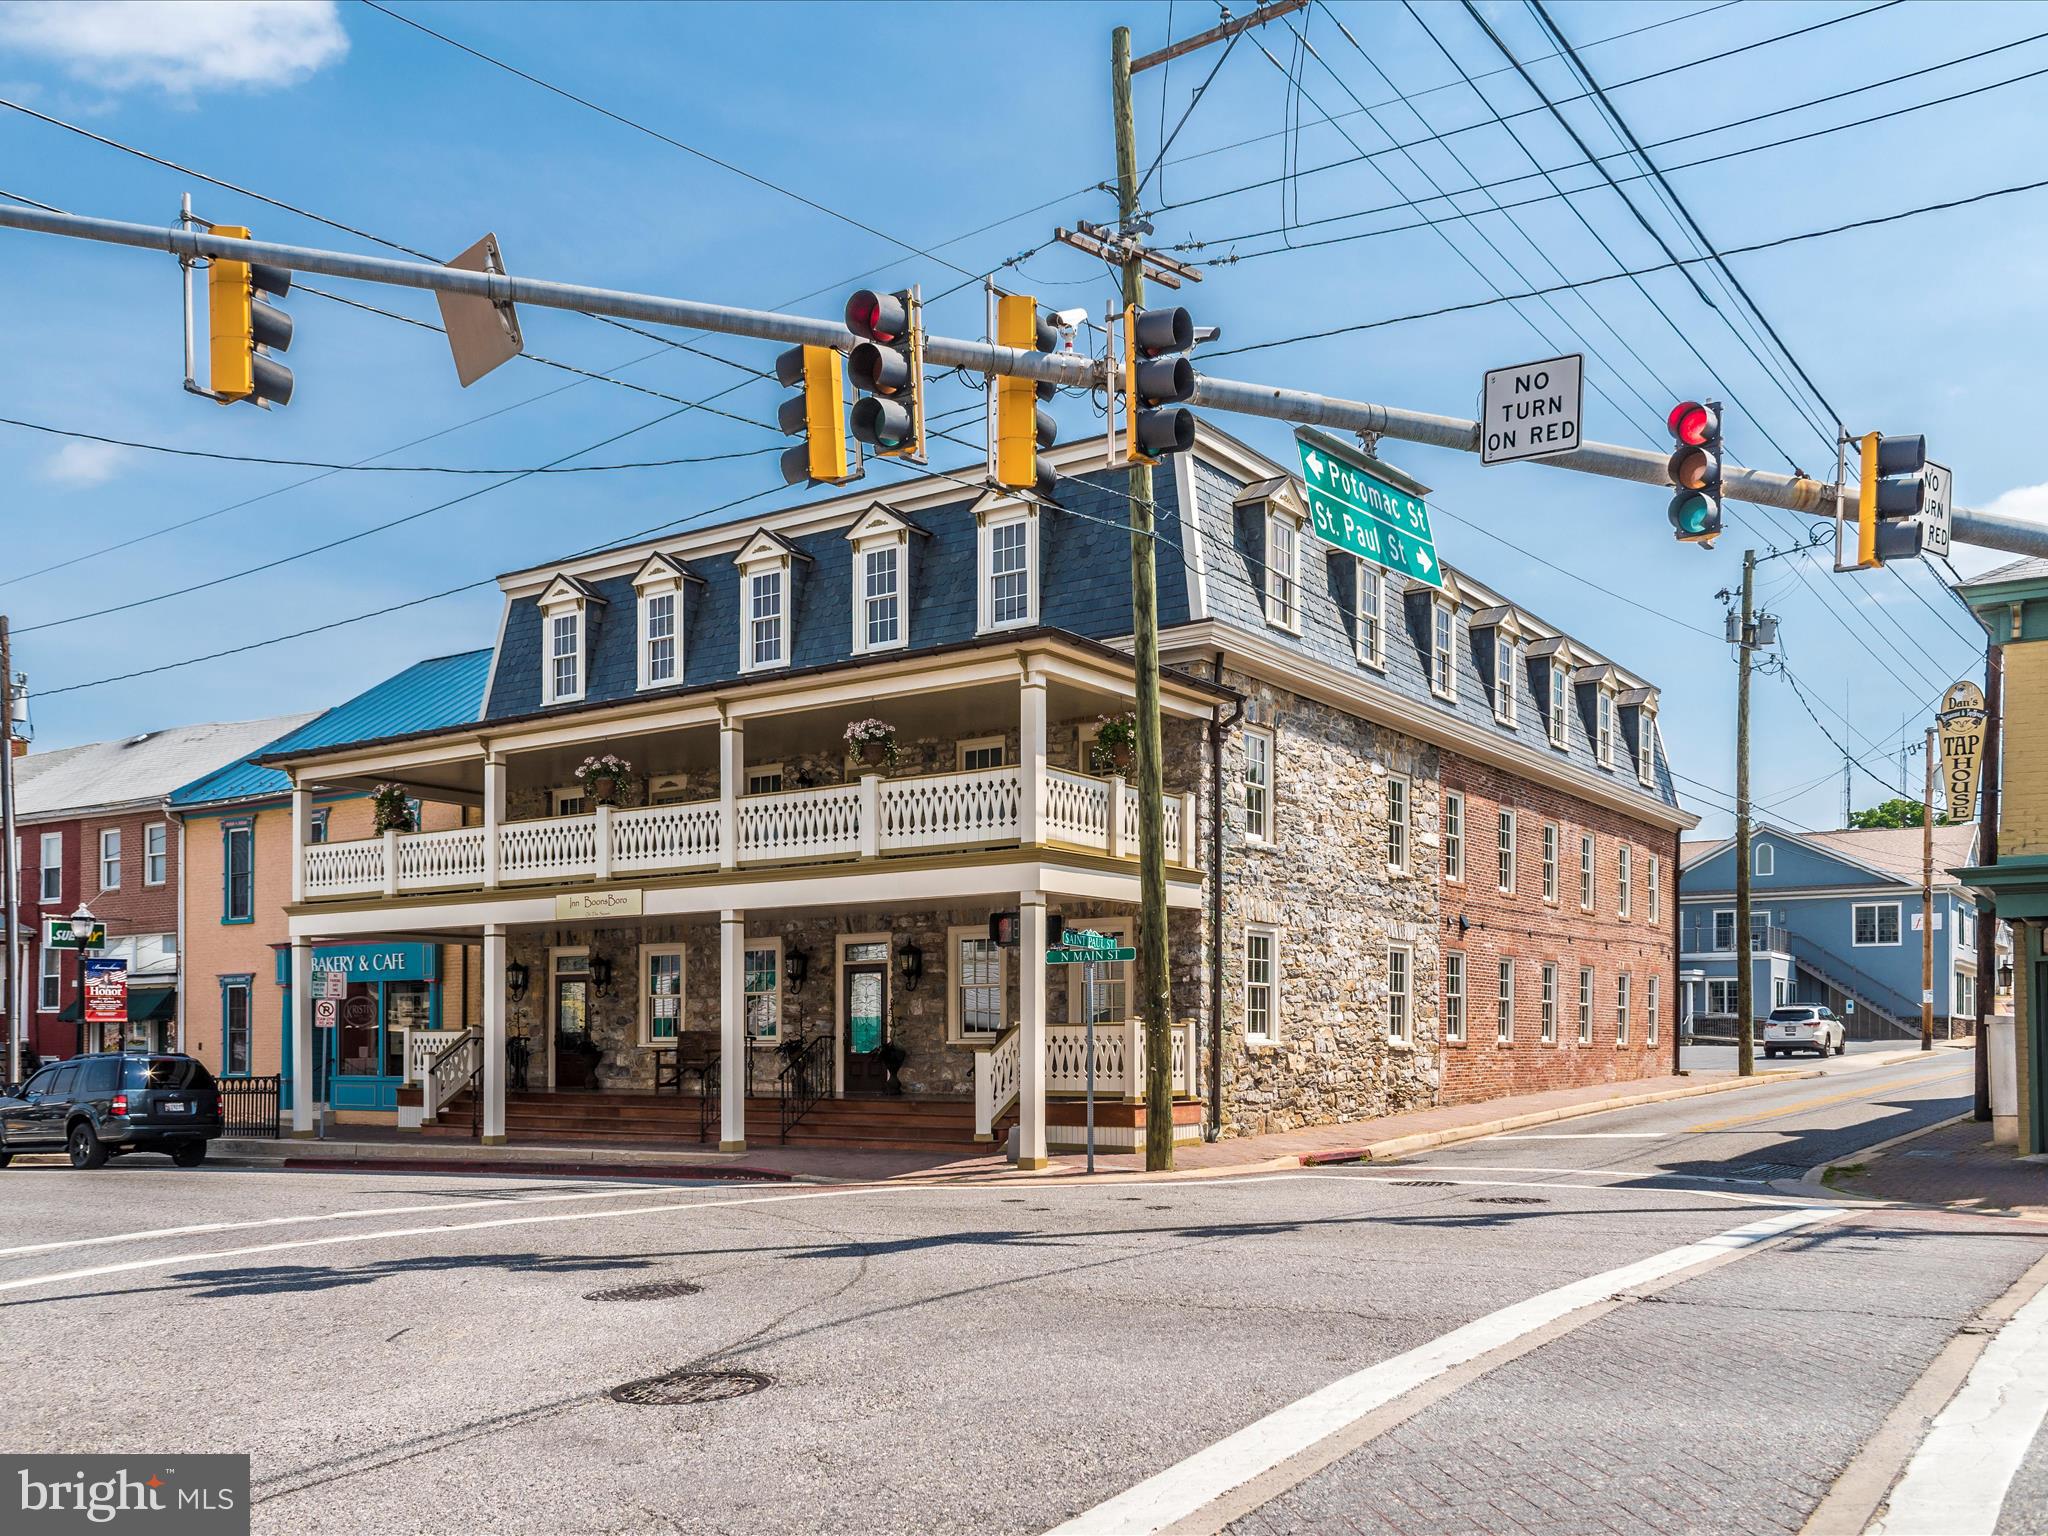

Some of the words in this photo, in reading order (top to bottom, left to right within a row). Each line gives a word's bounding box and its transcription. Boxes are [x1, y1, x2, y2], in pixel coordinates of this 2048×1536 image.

[1515, 372, 1549, 394] NO
[1502, 395, 1562, 422] TURN
[1488, 430, 1516, 451] ON
[1530, 421, 1575, 444] RED
[1924, 471, 1939, 491] NO
[1328, 460, 1401, 520] Potomac
[1407, 501, 1426, 532] St
[1924, 499, 1943, 519] URN
[1315, 501, 1339, 537] St.
[1343, 513, 1381, 554] Paul
[1388, 533, 1407, 565] St
[1929, 525, 1947, 545] RED
[1948, 697, 1978, 710] Dan's
[1944, 735, 1980, 756] TAP
[1951, 757, 1973, 818] HOUSE
[569, 897, 579, 909] Inn
[584, 894, 628, 908] BoonsBoro
[1065, 933, 1086, 946] SAINT
[1088, 937, 1105, 949] PAUL
[1106, 939, 1115, 949] ST
[311, 955, 355, 972] BAKERY
[359, 955, 369, 971] &
[373, 953, 405, 971] CAFE
[1061, 951, 1069, 961] N
[1073, 950, 1103, 961] MAIN
[1107, 950, 1120, 960] ST
[90, 987, 122, 996] Honor
